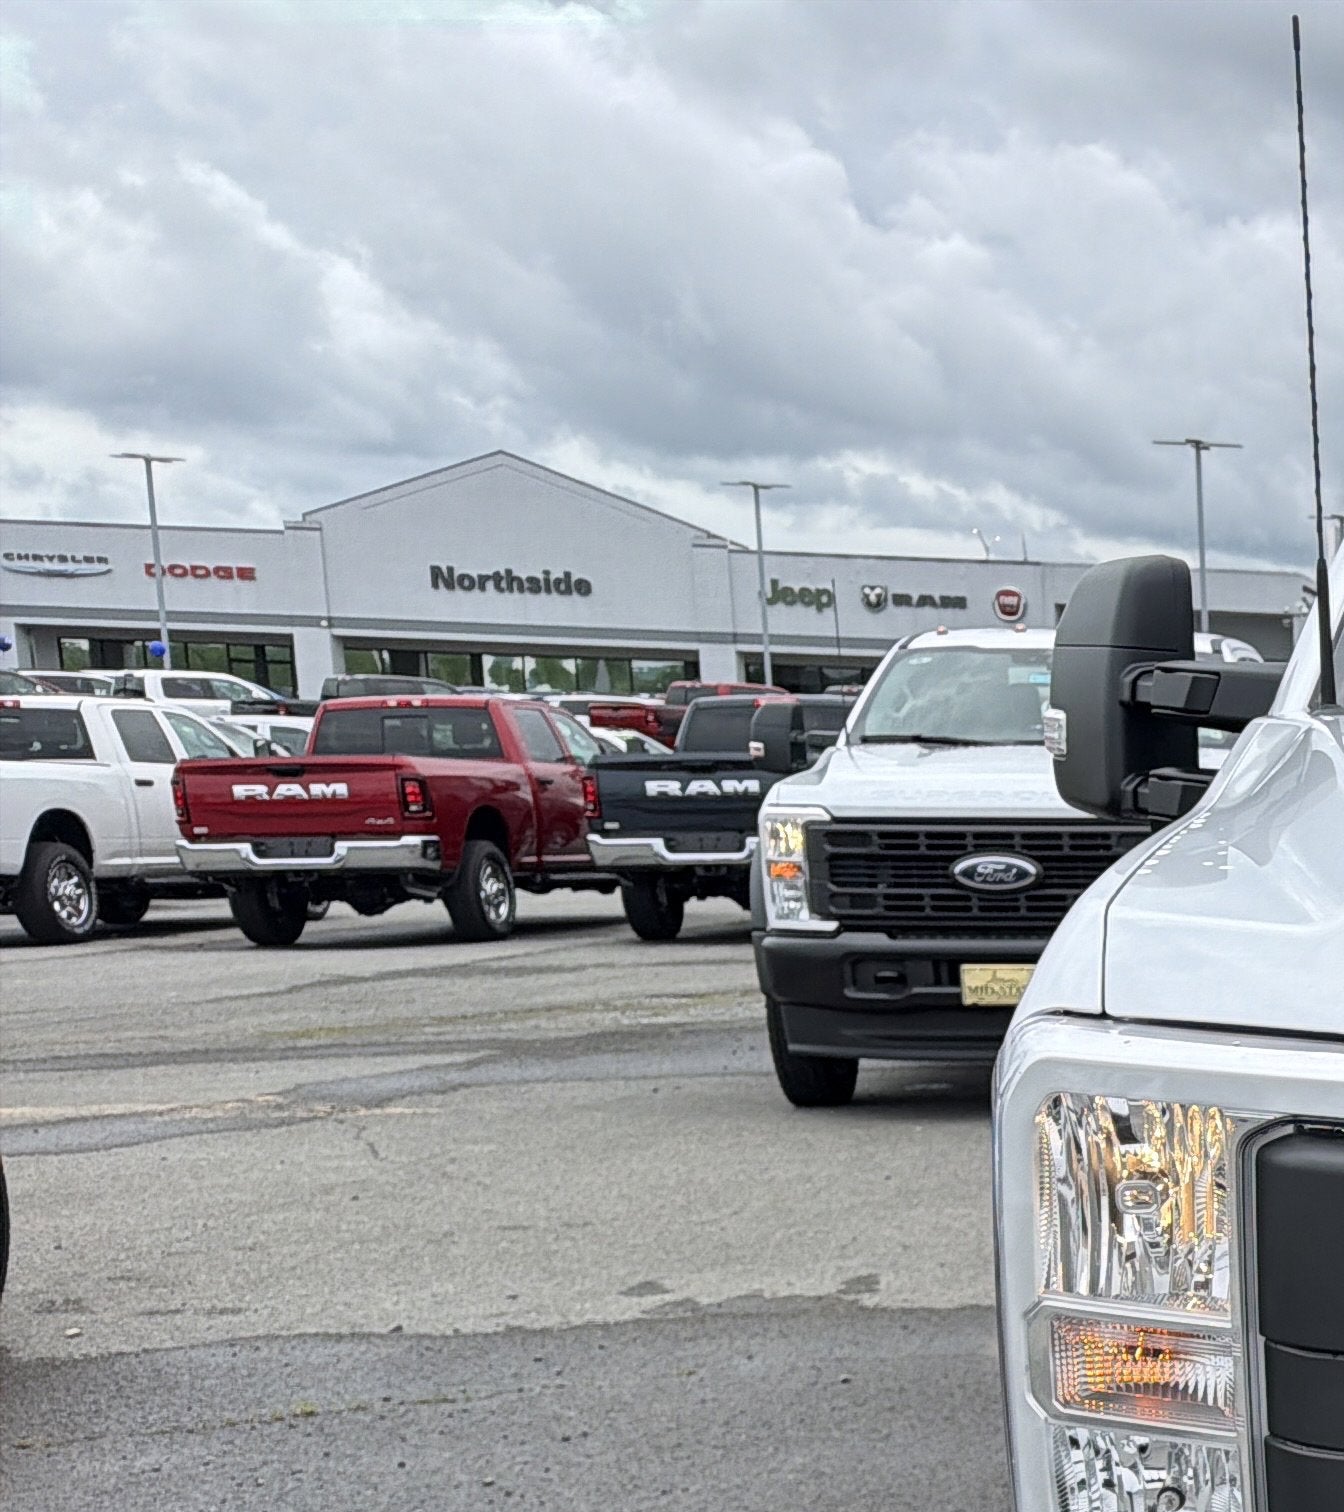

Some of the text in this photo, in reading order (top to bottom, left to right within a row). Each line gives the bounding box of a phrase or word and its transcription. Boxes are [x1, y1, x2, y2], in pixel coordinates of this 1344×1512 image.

[2, 552, 109, 565] CHRYSLER
[144, 563, 256, 581] DODGE
[429, 564, 593, 597] Northside
[766, 578, 833, 613] Jeep
[892, 593, 968, 609] RAM
[232, 783, 349, 800] RAM
[644, 779, 761, 797] RAM
[973, 863, 1018, 883] Ford
